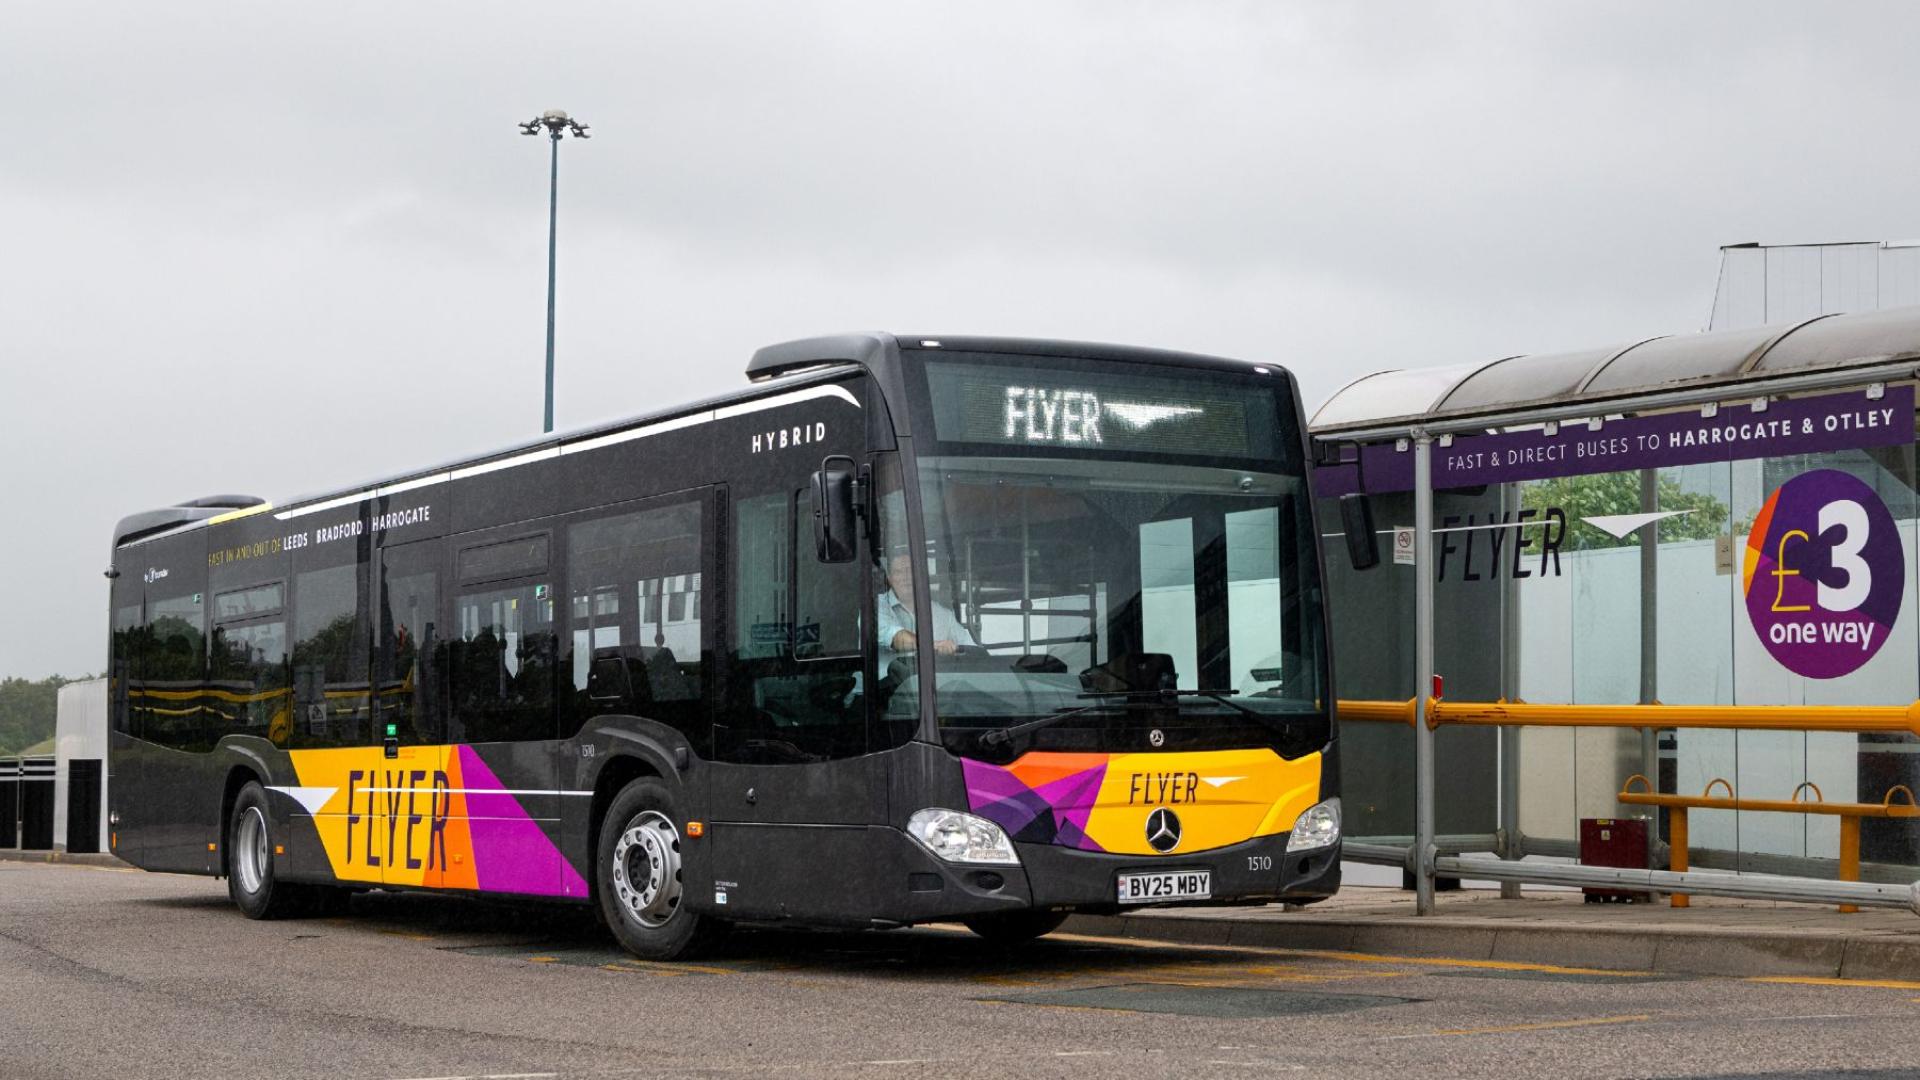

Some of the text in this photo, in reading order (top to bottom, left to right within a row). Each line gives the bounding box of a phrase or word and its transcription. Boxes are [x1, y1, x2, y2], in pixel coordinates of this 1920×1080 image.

[1005, 386, 1103, 443] FLYER
[752, 422, 825, 454] HYBRID
[1447, 408, 1894, 471] FAST & DIRECT BUSES TO HARROGATE & OTLEY
[208, 505, 431, 568] FAST IN AND OUT OF LEEDS BRADFORD HARROGATE
[1438, 507, 1566, 583] FLYER
[1769, 622, 1875, 650] one way
[1129, 772, 1199, 805] FLYER
[347, 770, 450, 872] FLYER
[1130, 873, 1208, 897] BV25 MBY
[1248, 856, 1272, 871] 1510
